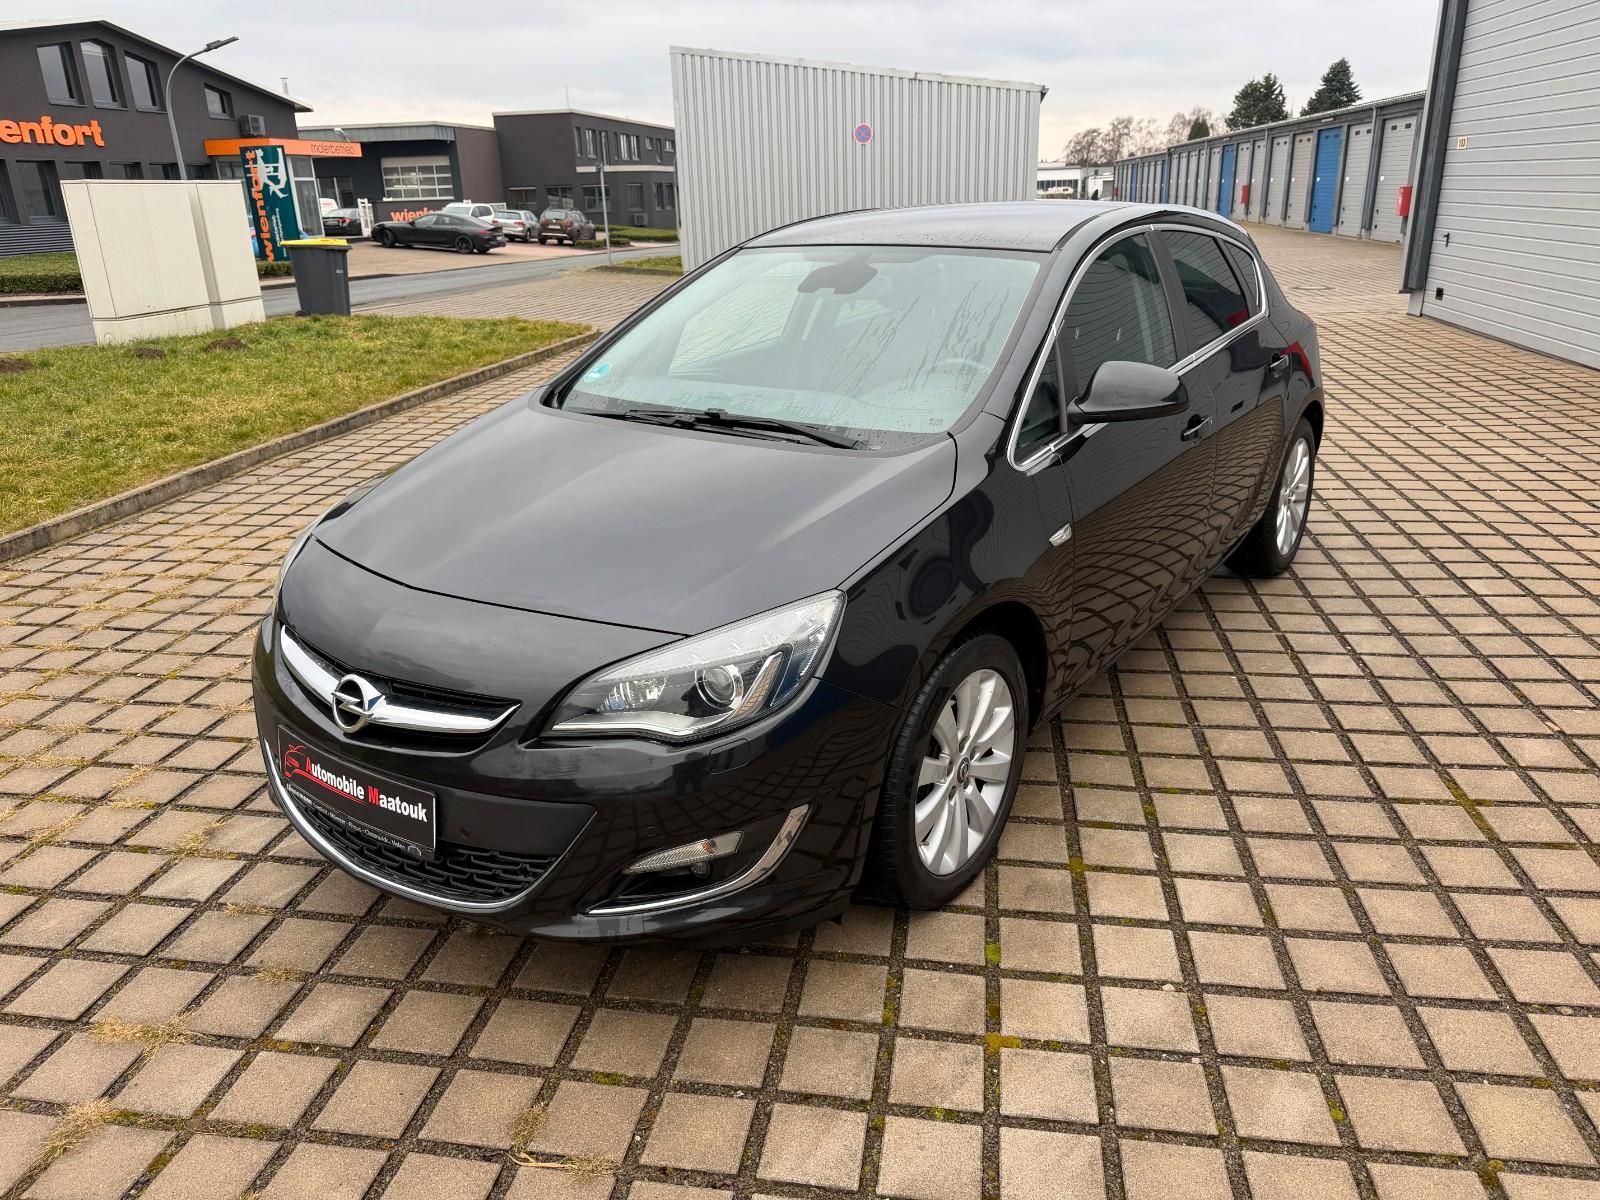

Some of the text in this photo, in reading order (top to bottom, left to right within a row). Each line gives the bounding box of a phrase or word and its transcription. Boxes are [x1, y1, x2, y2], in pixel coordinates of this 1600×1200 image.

[245, 150, 275, 263] wienfort
[305, 757, 365, 799] Automobile
[367, 785, 427, 823] Maatouk
